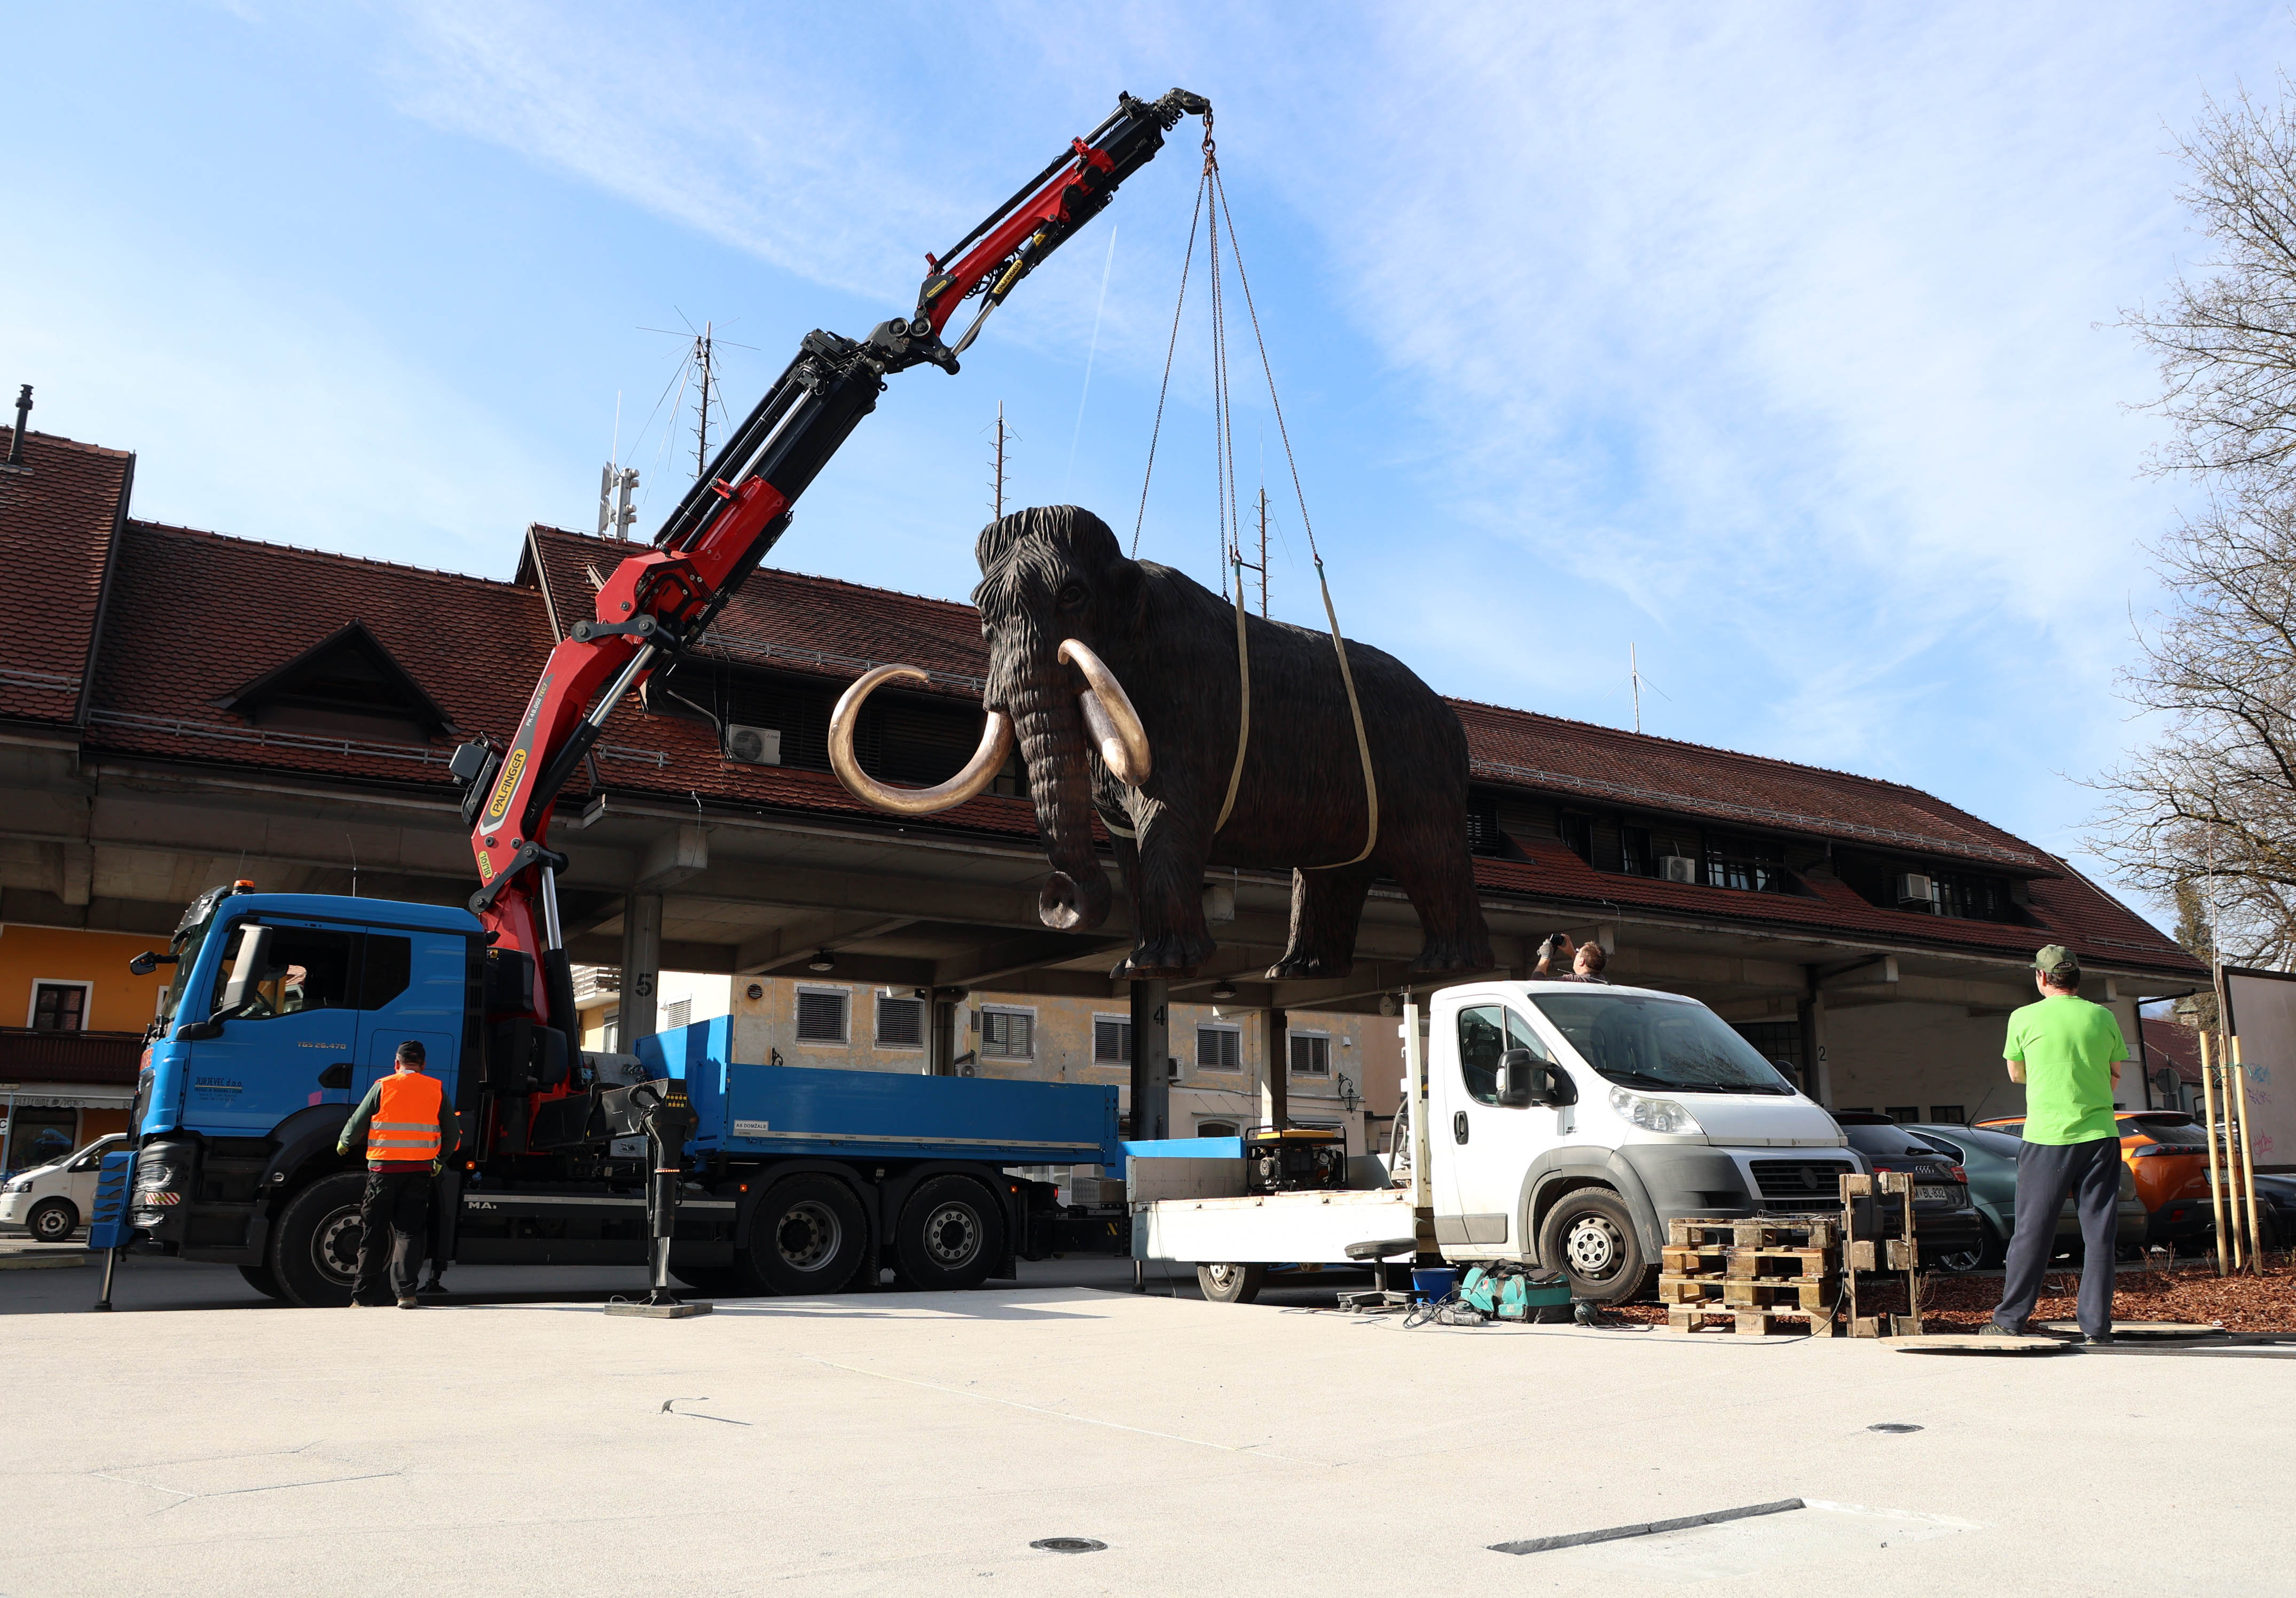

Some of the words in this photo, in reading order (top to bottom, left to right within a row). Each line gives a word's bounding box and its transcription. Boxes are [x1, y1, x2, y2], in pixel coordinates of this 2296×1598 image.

[996, 261, 1022, 293] PALFINGER
[525, 717, 533, 726] PK
[530, 698, 542, 717] 48.002
[538, 683, 547, 697] TEC7
[492, 753, 524, 812] PALFINGER
[480, 853, 491, 876] BIJOL
[635, 973, 652, 997] 5
[1153, 1005, 1166, 1026] 4
[1818, 1045, 1827, 1062] 2
[195, 1076, 225, 1086] JURJEVEC
[226, 1078, 243, 1087] d.o.o.
[1922, 1187, 1945, 1198] BL-832
